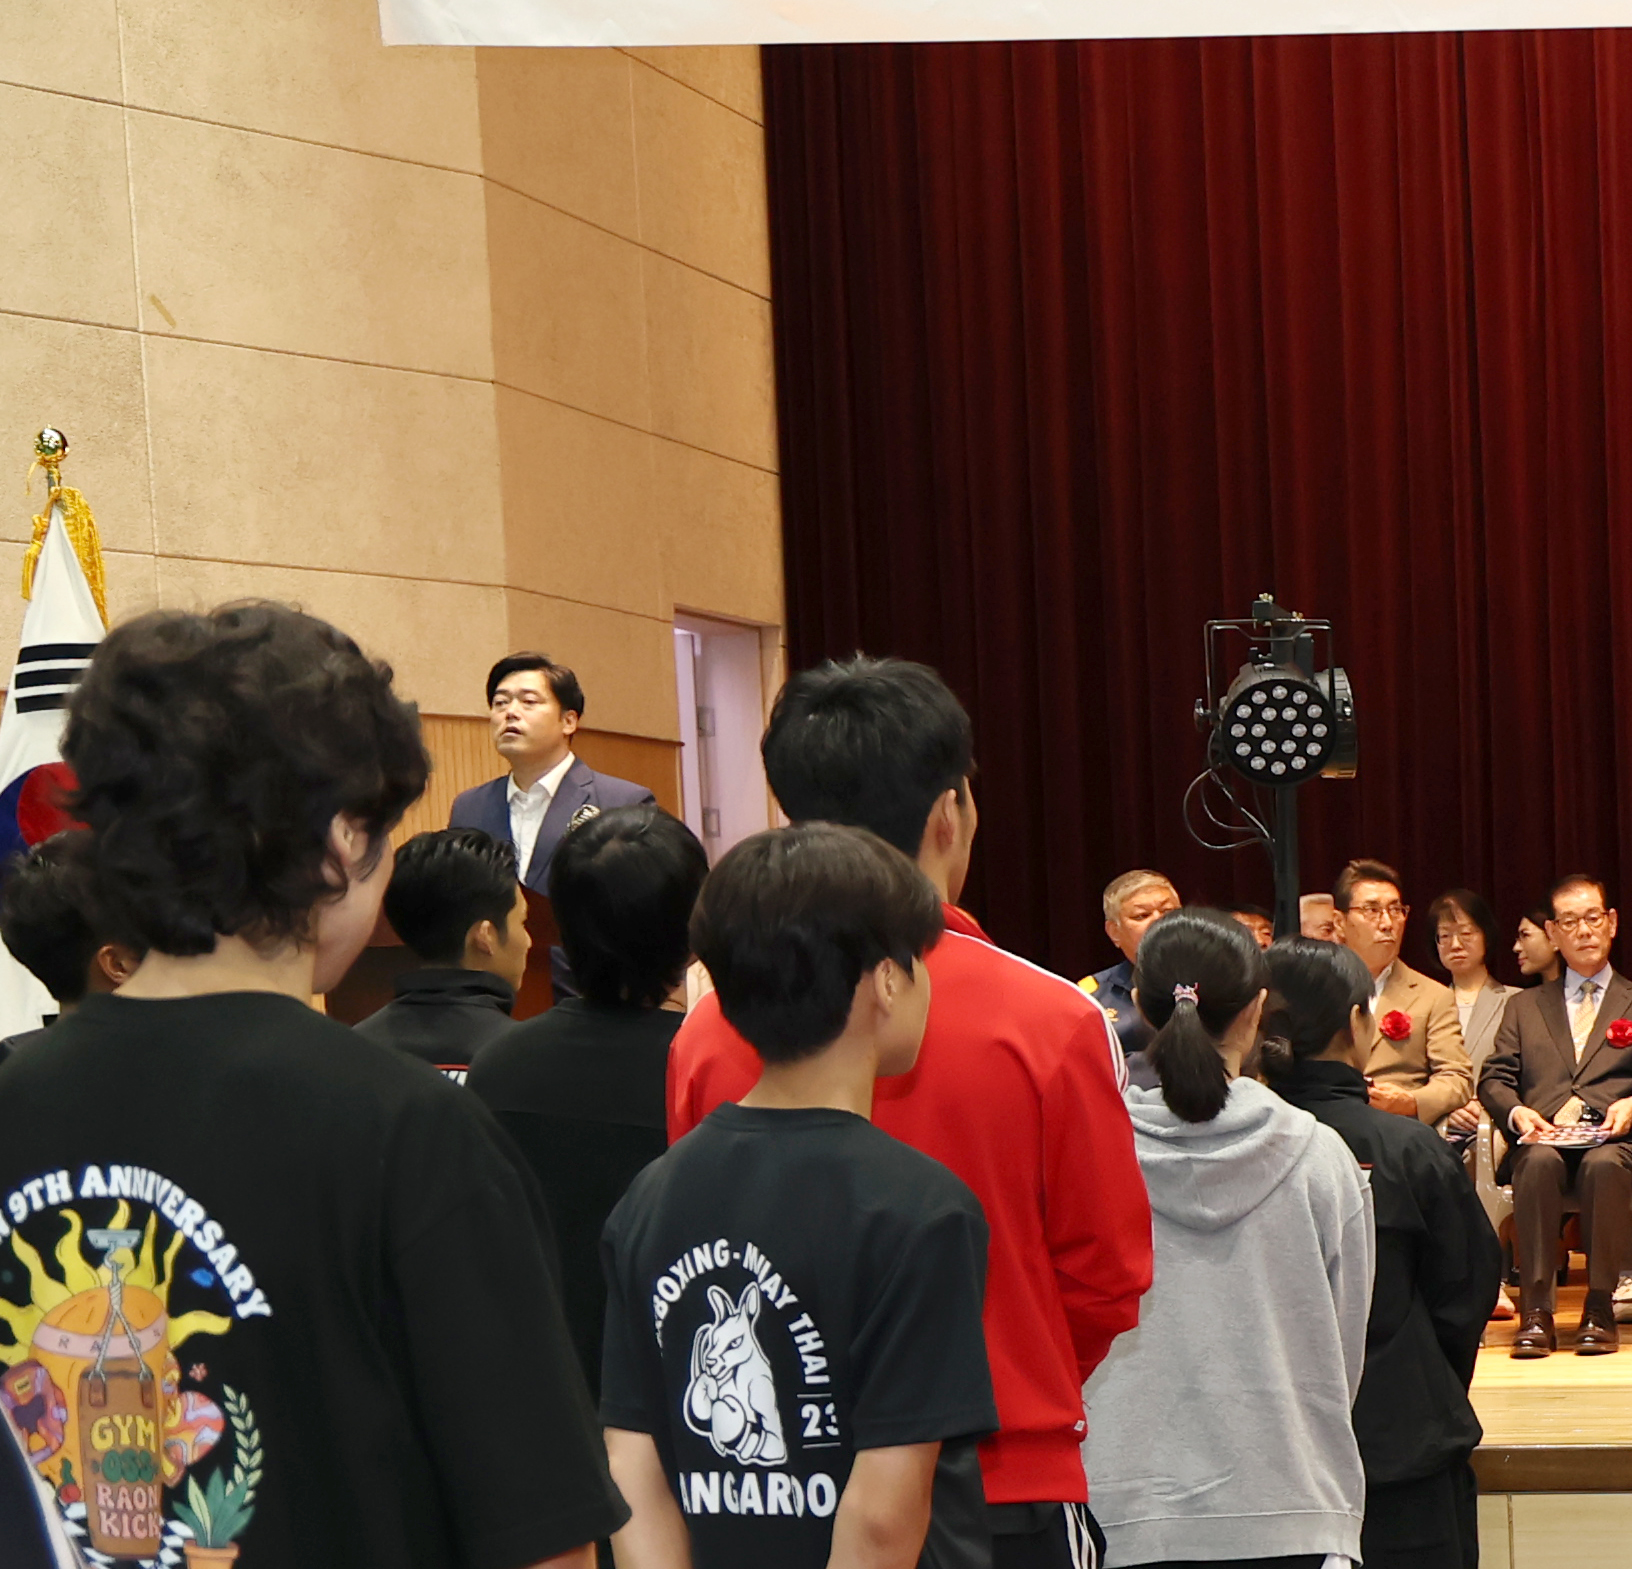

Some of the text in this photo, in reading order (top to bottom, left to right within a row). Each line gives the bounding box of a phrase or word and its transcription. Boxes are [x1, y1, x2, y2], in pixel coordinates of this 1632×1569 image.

[8, 1164, 273, 1319] 9TH ANNIVERSARY
[788, 1312, 831, 1384] THAI
[90, 1413, 156, 1453] GYM
[95, 1482, 159, 1509] RAON
[101, 1509, 162, 1540] KICK
